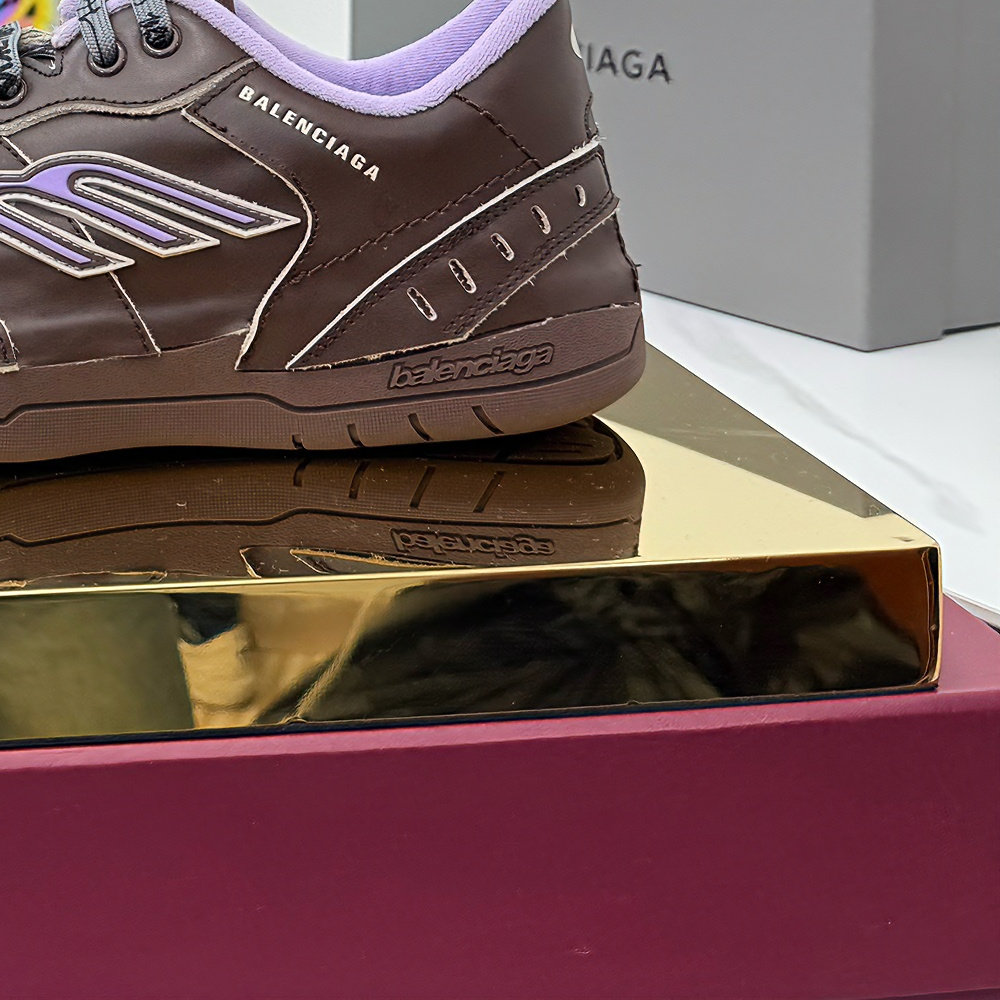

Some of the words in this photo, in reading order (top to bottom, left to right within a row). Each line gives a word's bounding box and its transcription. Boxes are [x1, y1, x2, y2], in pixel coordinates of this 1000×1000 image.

[580, 43, 672, 84] IAGA
[238, 85, 380, 182] BALENCIAGA
[388, 343, 554, 389] balenciaga
